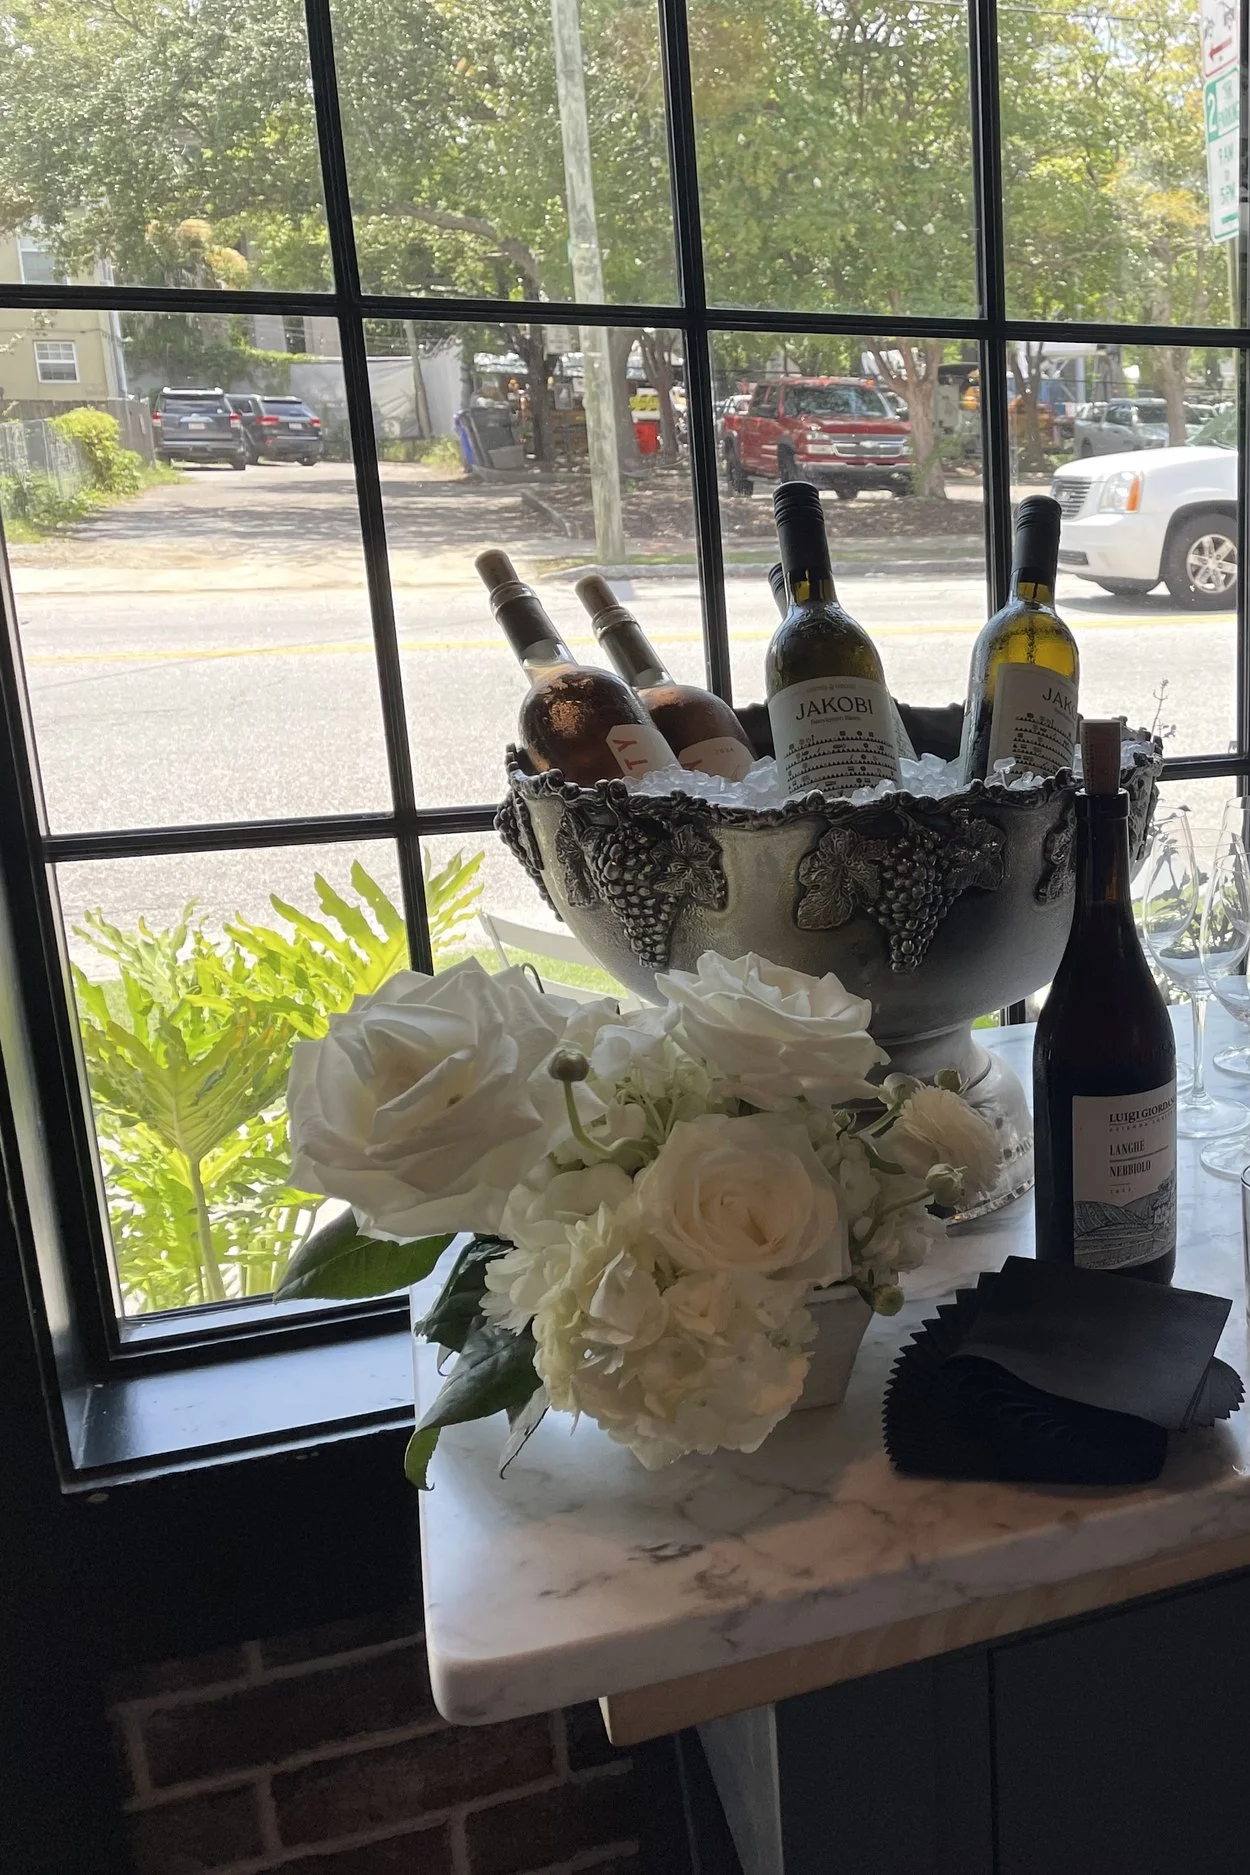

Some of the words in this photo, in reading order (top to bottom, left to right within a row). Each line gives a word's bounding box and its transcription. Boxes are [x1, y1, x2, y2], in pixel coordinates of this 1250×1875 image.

[1207, 92, 1217, 132] 2
[796, 695, 873, 720] JAKOBI
[1109, 1140, 1145, 1156] LANGHE
[1110, 1160, 1151, 1177] NEBBIOLO
